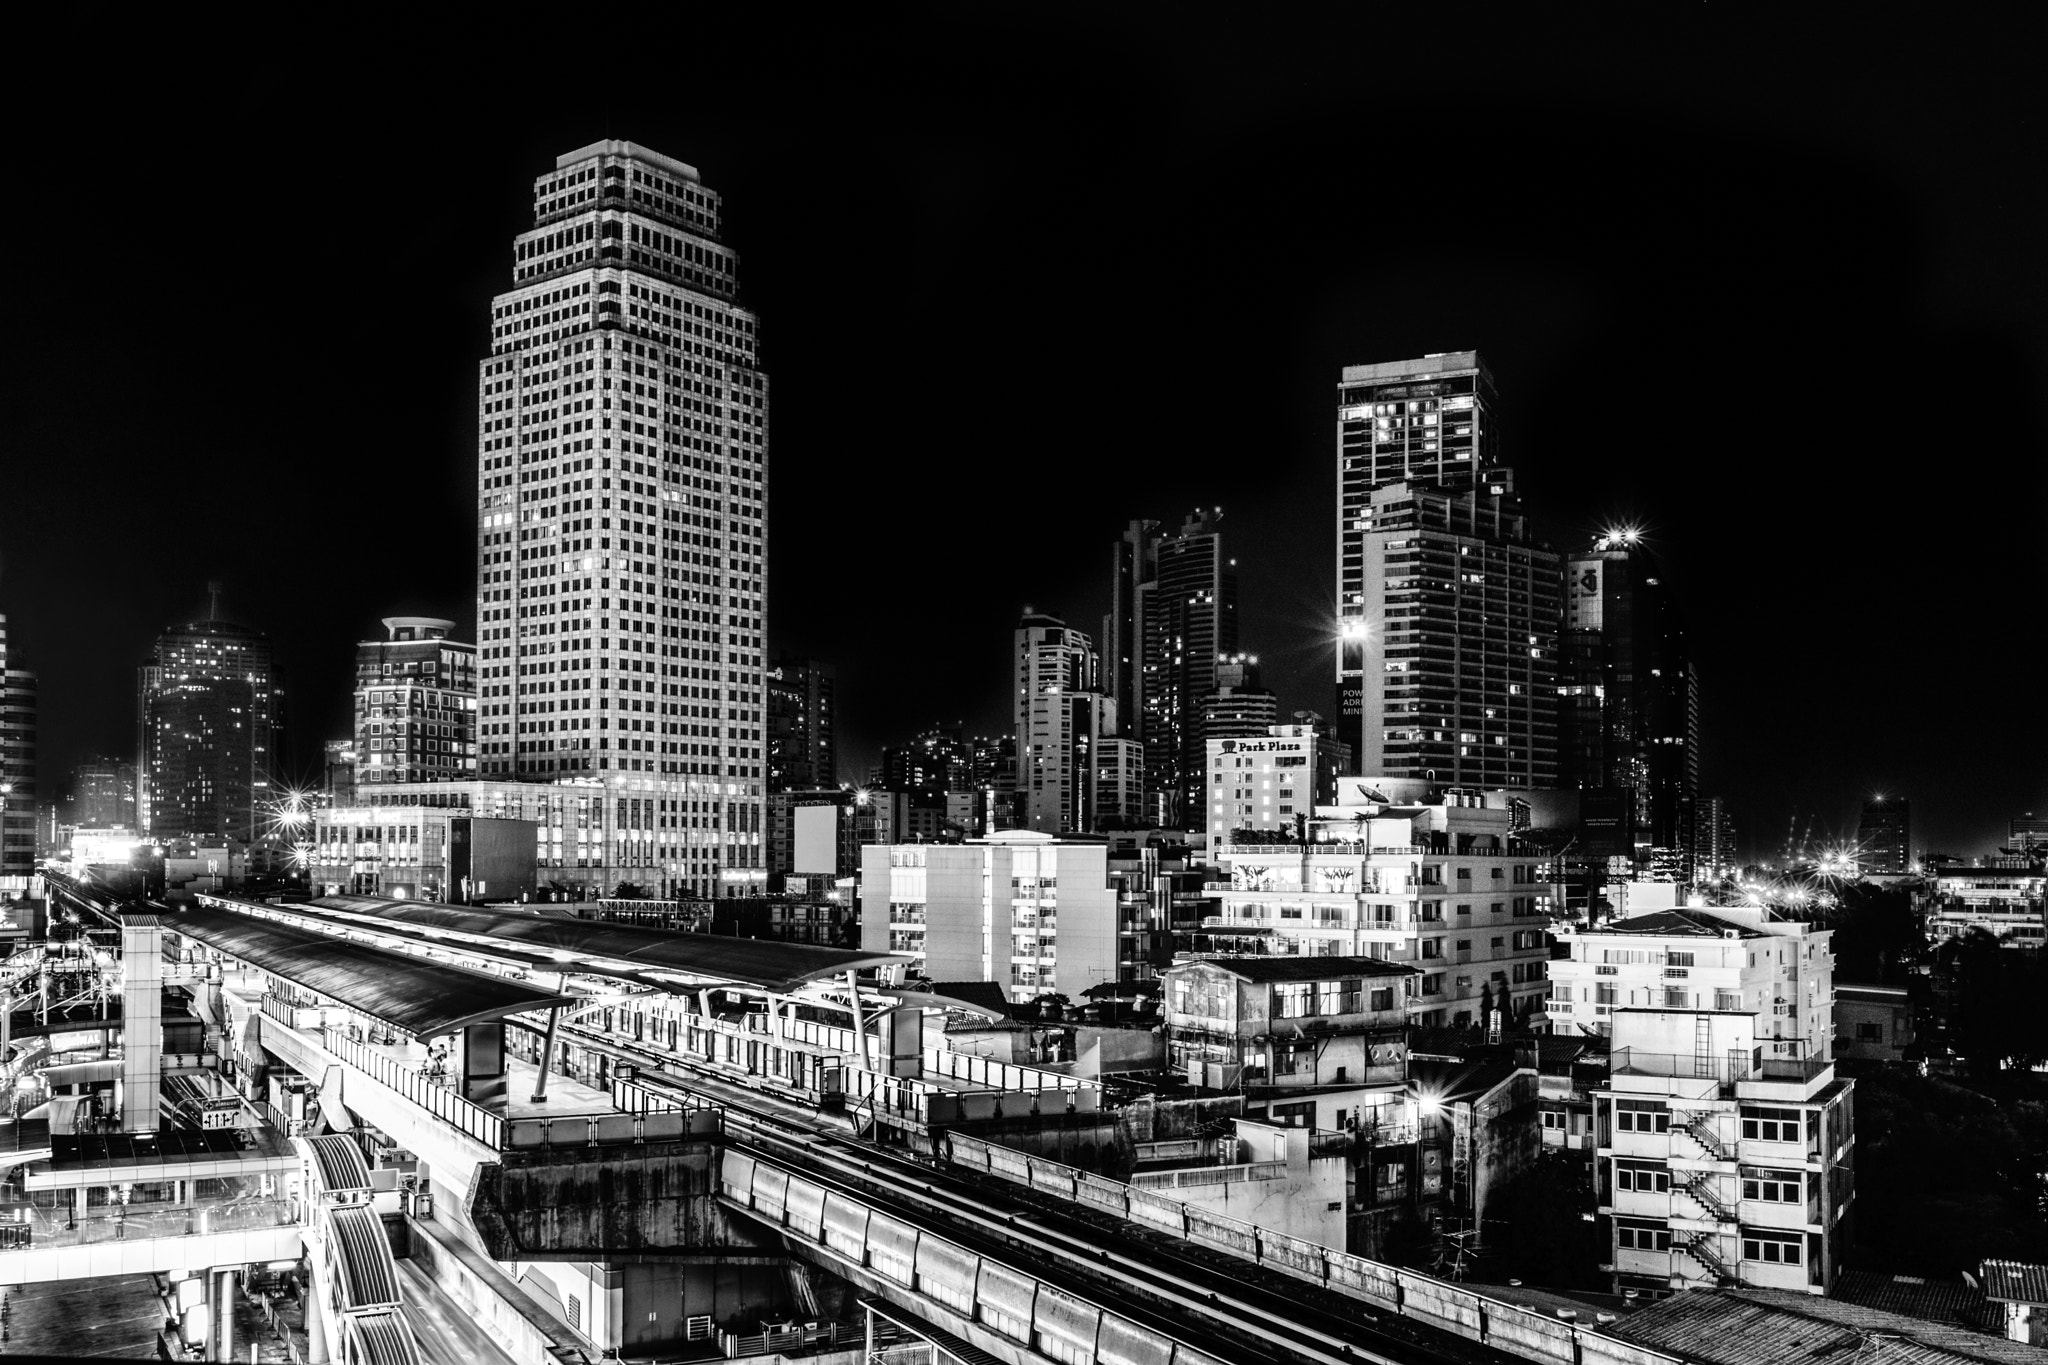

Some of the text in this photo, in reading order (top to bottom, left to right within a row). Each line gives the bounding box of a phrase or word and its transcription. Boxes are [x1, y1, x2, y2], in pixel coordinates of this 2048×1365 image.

[1239, 741, 1301, 752] Park Plaza
[330, 808, 371, 825] Exchange
